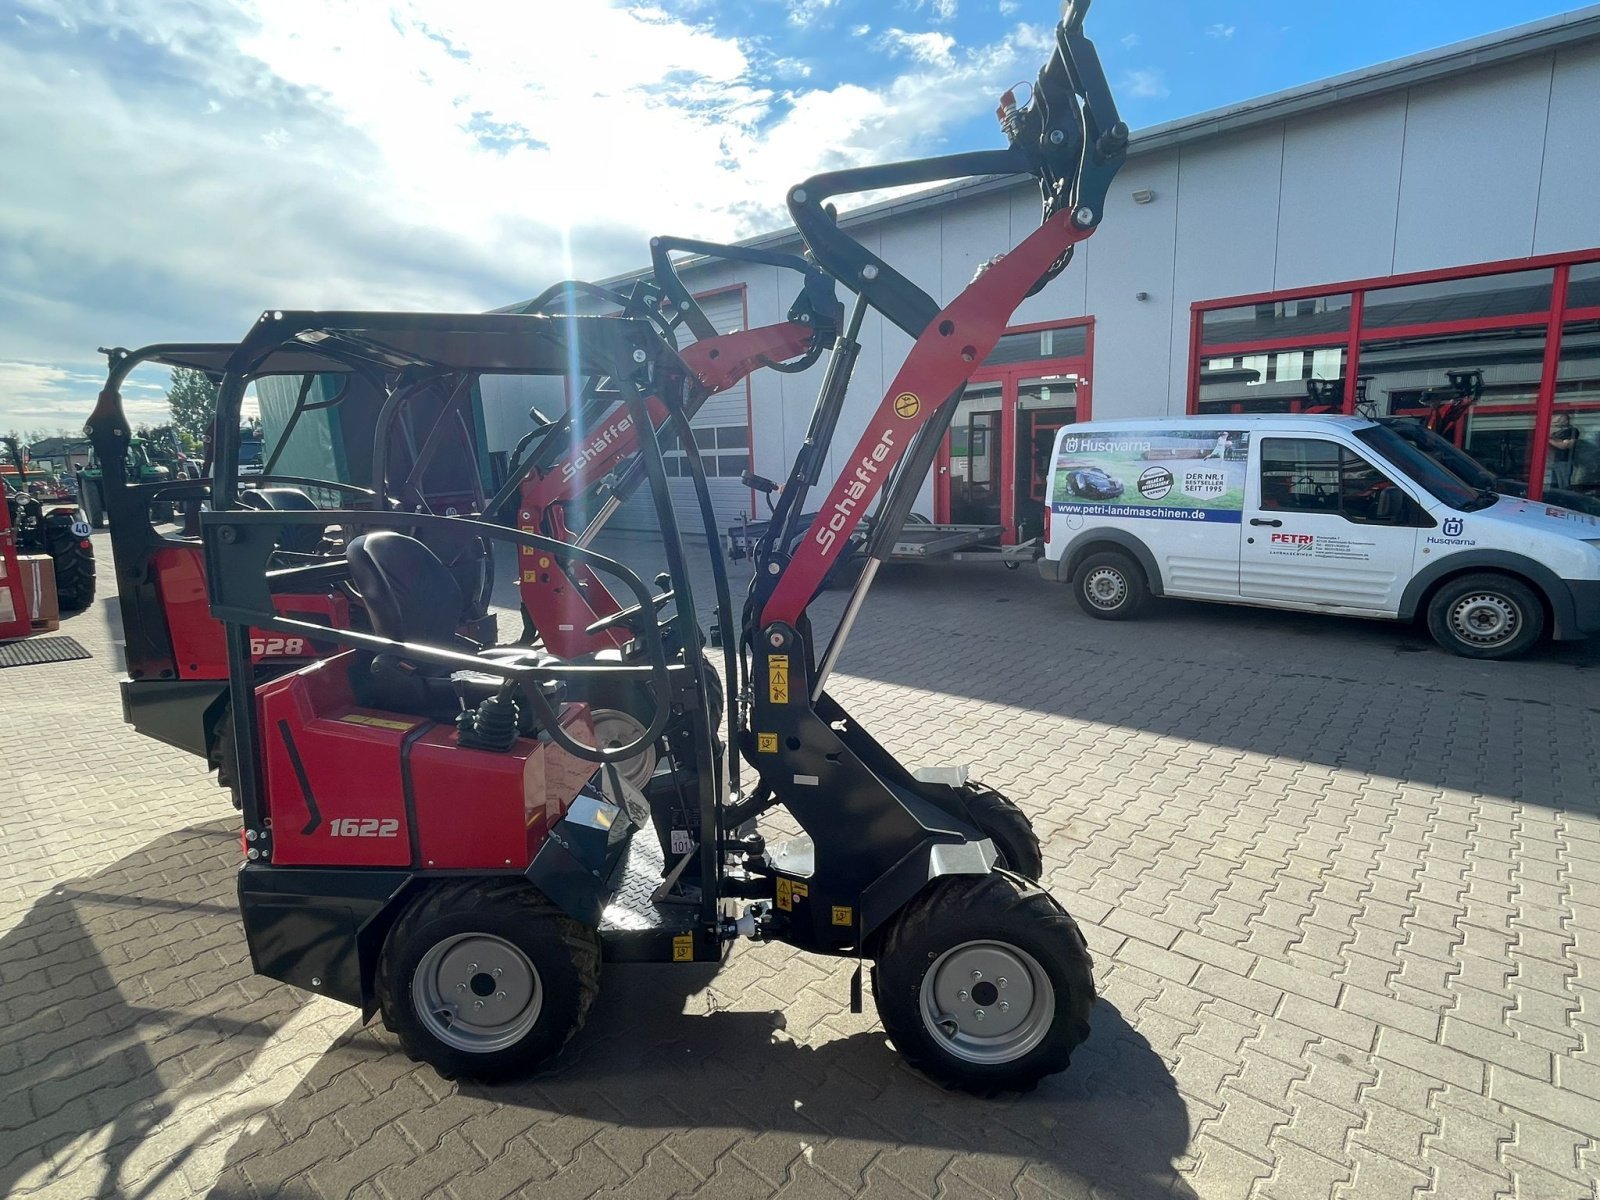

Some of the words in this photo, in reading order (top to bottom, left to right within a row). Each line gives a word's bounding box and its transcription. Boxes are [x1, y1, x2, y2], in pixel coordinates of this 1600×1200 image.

[1080, 439, 1151, 453] Husqvarna
[815, 429, 894, 556] Schäffer
[1058, 504, 1206, 520] www.petri-landmaschinen.de
[75, 524, 89, 534] 40
[1271, 533, 1314, 544] PETRI
[1427, 536, 1476, 546] Husqvarna
[250, 638, 304, 655] 628
[330, 818, 399, 837] 1622
[674, 841, 689, 852] 101
